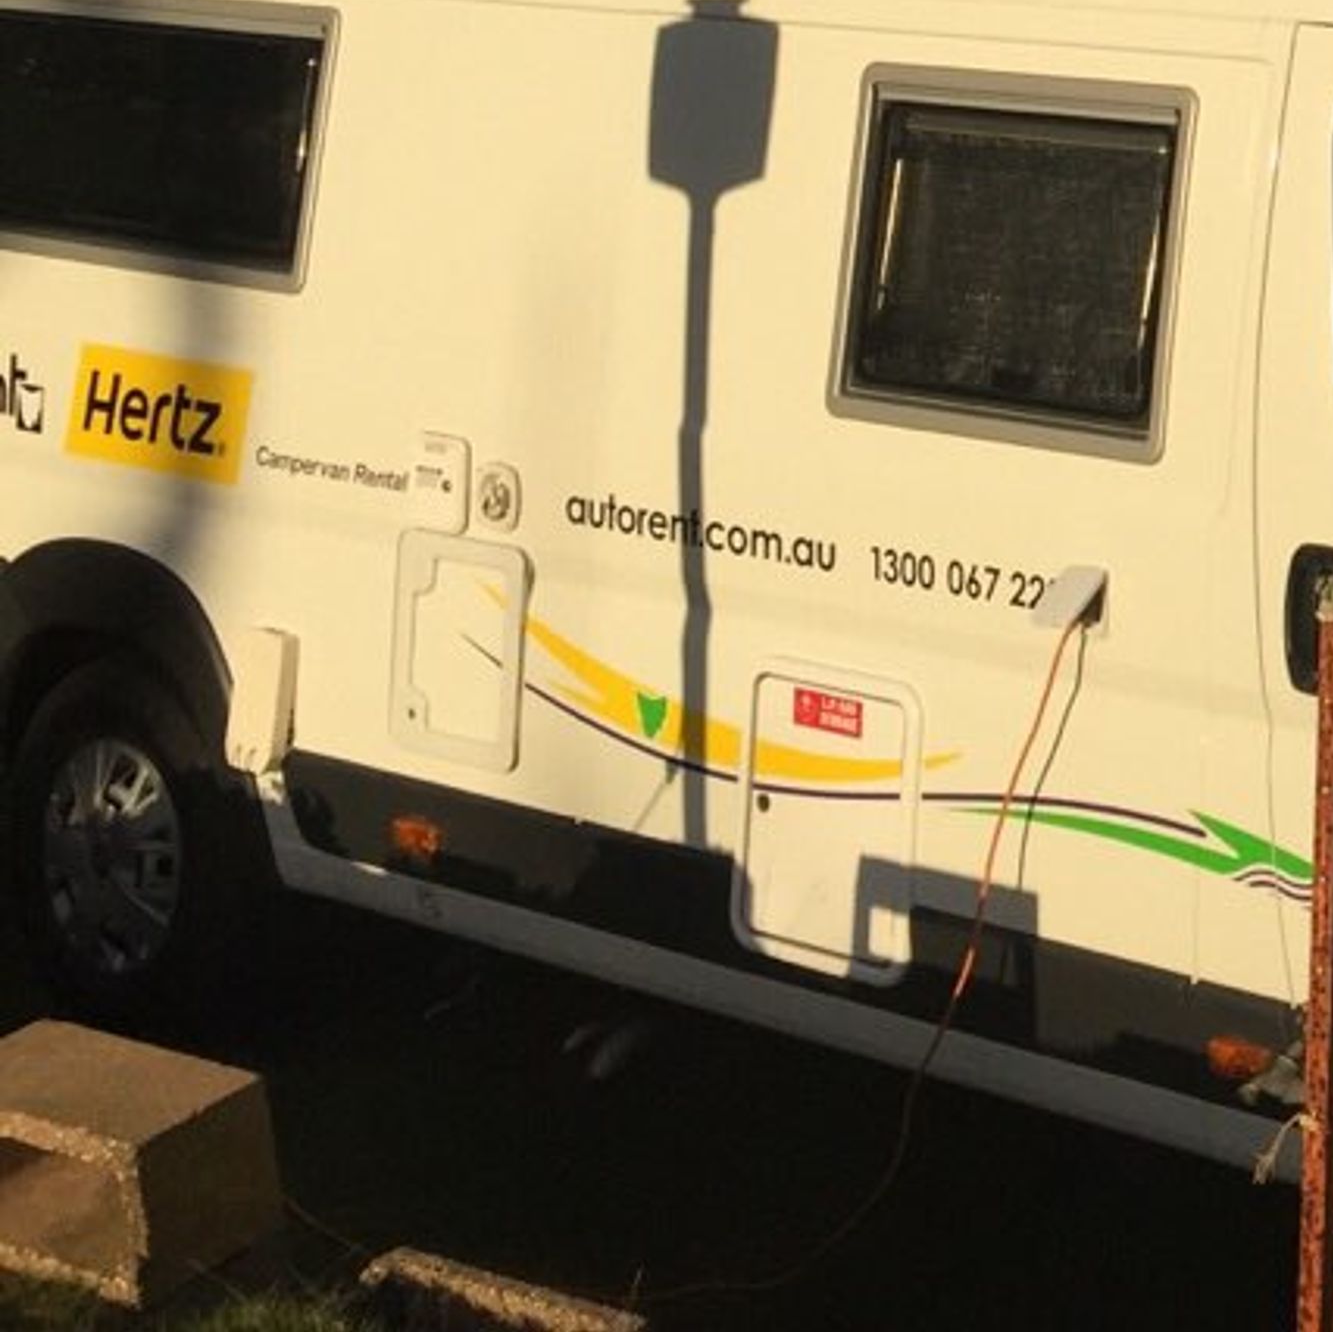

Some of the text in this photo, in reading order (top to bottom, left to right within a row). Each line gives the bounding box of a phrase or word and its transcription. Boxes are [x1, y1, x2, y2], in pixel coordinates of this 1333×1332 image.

[83, 369, 222, 456] Hertz
[256, 445, 350, 483] Campervan
[354, 463, 410, 492] Rental
[566, 492, 1055, 610] autorent.com.au 1300 067 22
